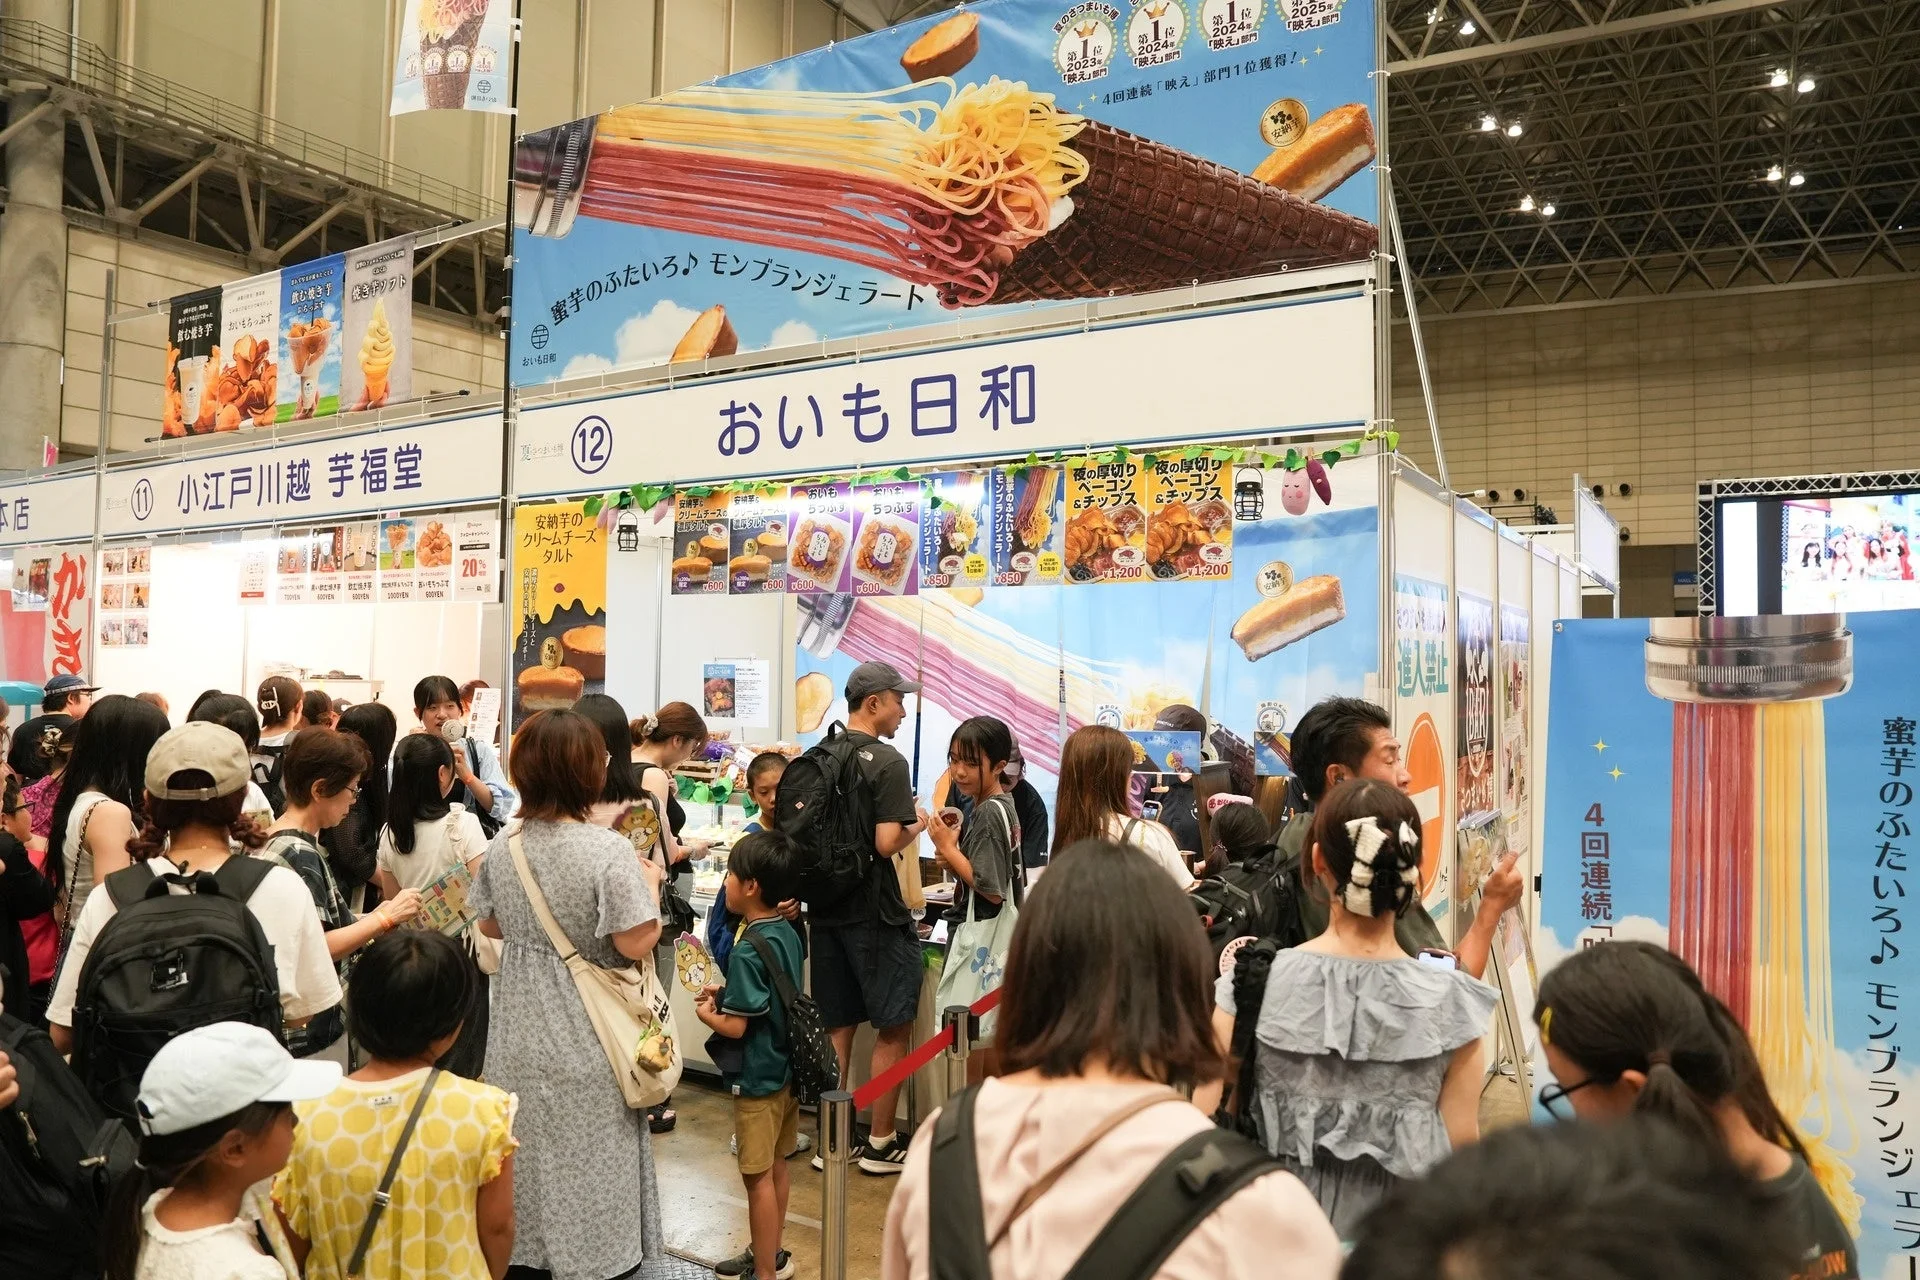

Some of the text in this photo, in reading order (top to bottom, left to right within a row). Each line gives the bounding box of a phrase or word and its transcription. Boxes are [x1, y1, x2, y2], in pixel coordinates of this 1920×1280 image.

[1053, 2, 1119, 34] 夏のさつまいも博
[1291, 3, 1334, 19] 2025年
[1212, 22, 1252, 38] 2024年
[1287, 13, 1339, 31] 「映え」部門
[1138, 19, 1175, 45] 第1位
[1138, 40, 1176, 56] 2024年
[1208, 32, 1258, 50] 「映え」部門
[1067, 39, 1103, 62] 第1位
[1067, 58, 1103, 72] 2023年
[1134, 50, 1180, 68] 「映え」部門
[1062, 68, 1108, 84] 「映え」部門
[351, 274, 407, 301] 焼き芋ソフト
[709, 252, 925, 311] モンブランジェラート
[291, 281, 334, 305] 飲む焼き芋
[177, 323, 214, 343] 飲む焼き芋
[522, 352, 557, 367] おいも日和
[717, 364, 1036, 457] おいも日和
[1073, 463, 1137, 481] 夜の厚切り
[1154, 456, 1222, 476] 夜の厚切り
[177, 442, 422, 514] 小江戸川越 芋福堂
[1160, 473, 1218, 488] ベーコン
[808, 486, 837, 500] おいも
[1078, 479, 1133, 494] ベーコン
[1073, 492, 1137, 509] &チップス
[535, 512, 583, 531] 安納芋の
[995, 474, 1004, 572] モンブランジェラート
[543, 548, 573, 564] タルト
[995, 572, 1021, 585] ¥850
[1103, 567, 1142, 579] ¥1,200
[1187, 564, 1228, 577] ¥1,200
[703, 581, 725, 591] ¥600
[763, 580, 784, 590] ¥600
[791, 580, 814, 590] ¥600
[857, 583, 880, 593] ¥600
[924, 575, 949, 585] ¥850
[387, 592, 409, 600] 1000YEN
[1397, 639, 1449, 698] 進入禁止
